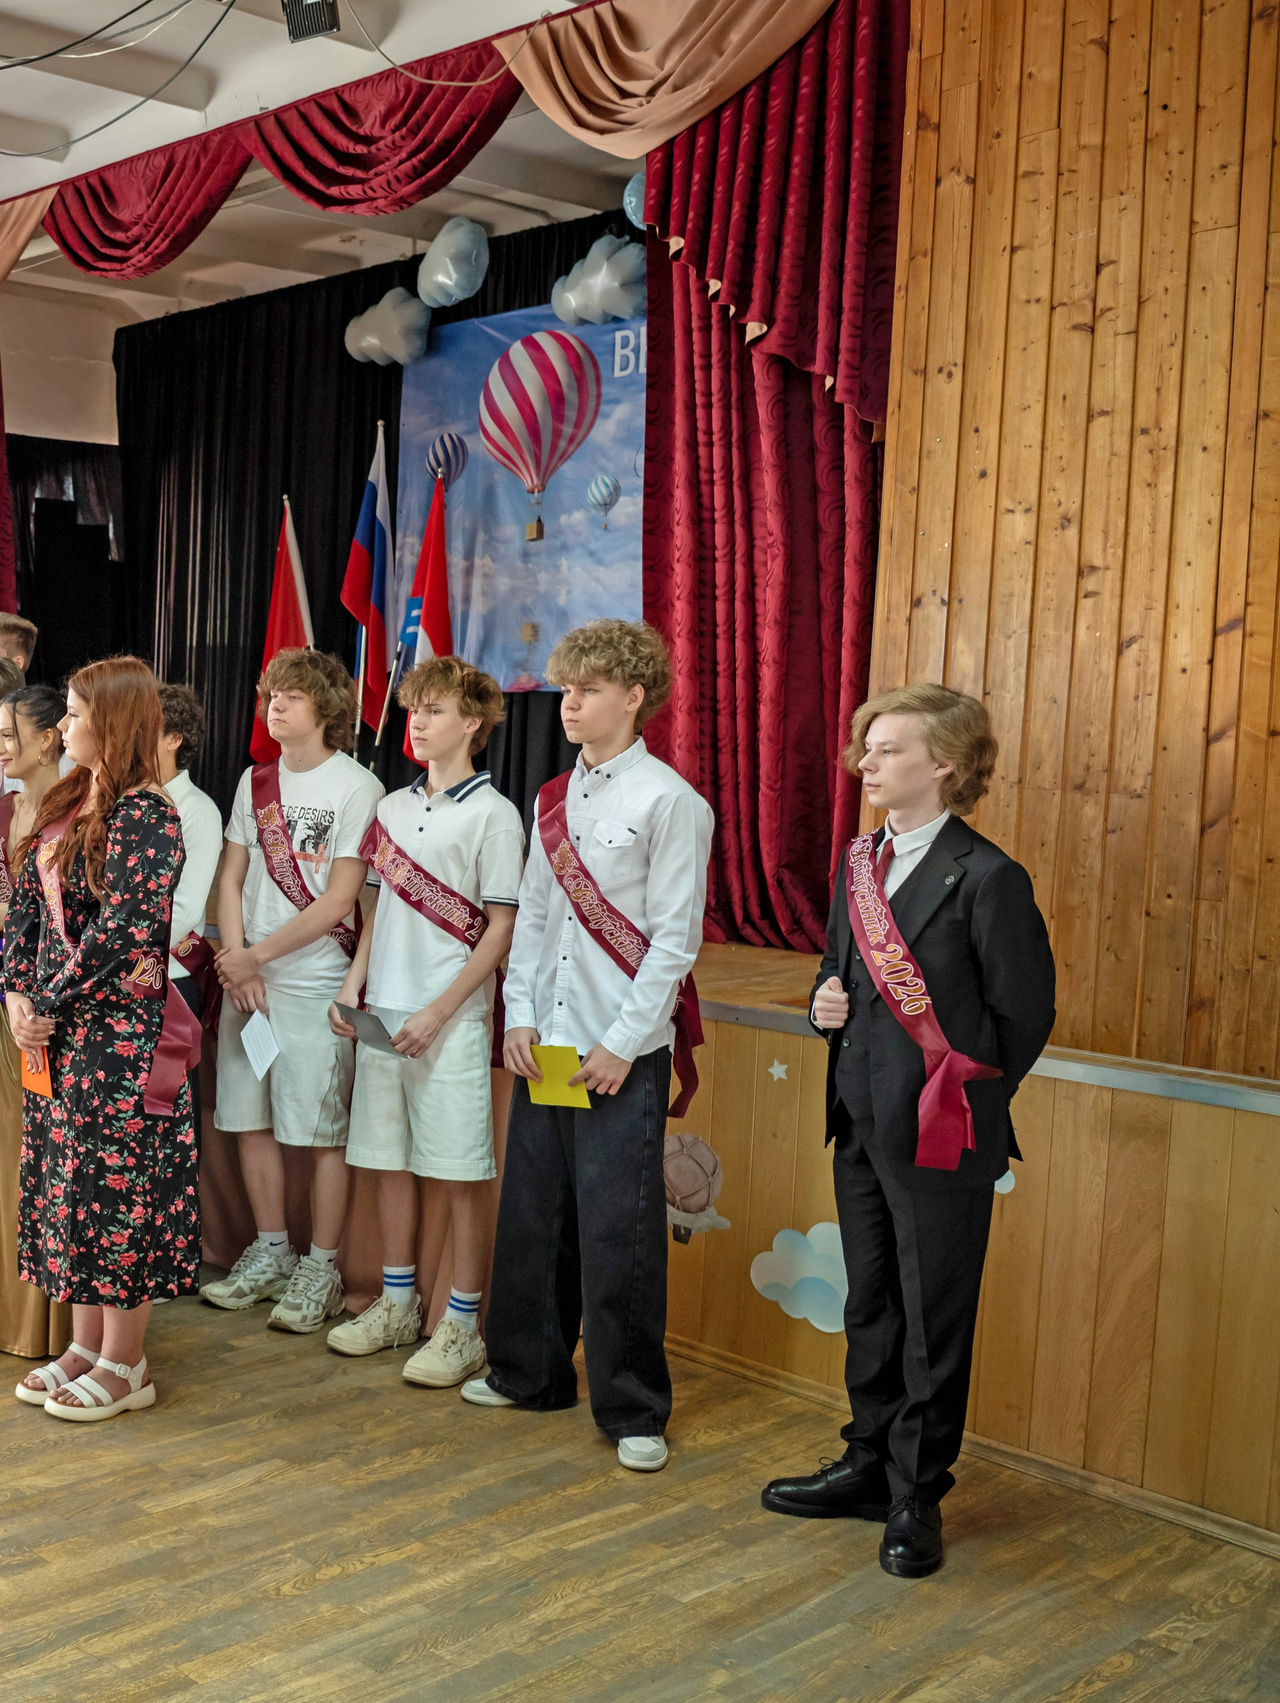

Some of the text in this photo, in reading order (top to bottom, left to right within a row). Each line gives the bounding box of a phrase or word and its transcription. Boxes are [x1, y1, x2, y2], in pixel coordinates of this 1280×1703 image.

[298, 807, 335, 825] DESIRS
[384, 854, 473, 930] Выпускник
[849, 836, 932, 1016] Выпускник 2026
